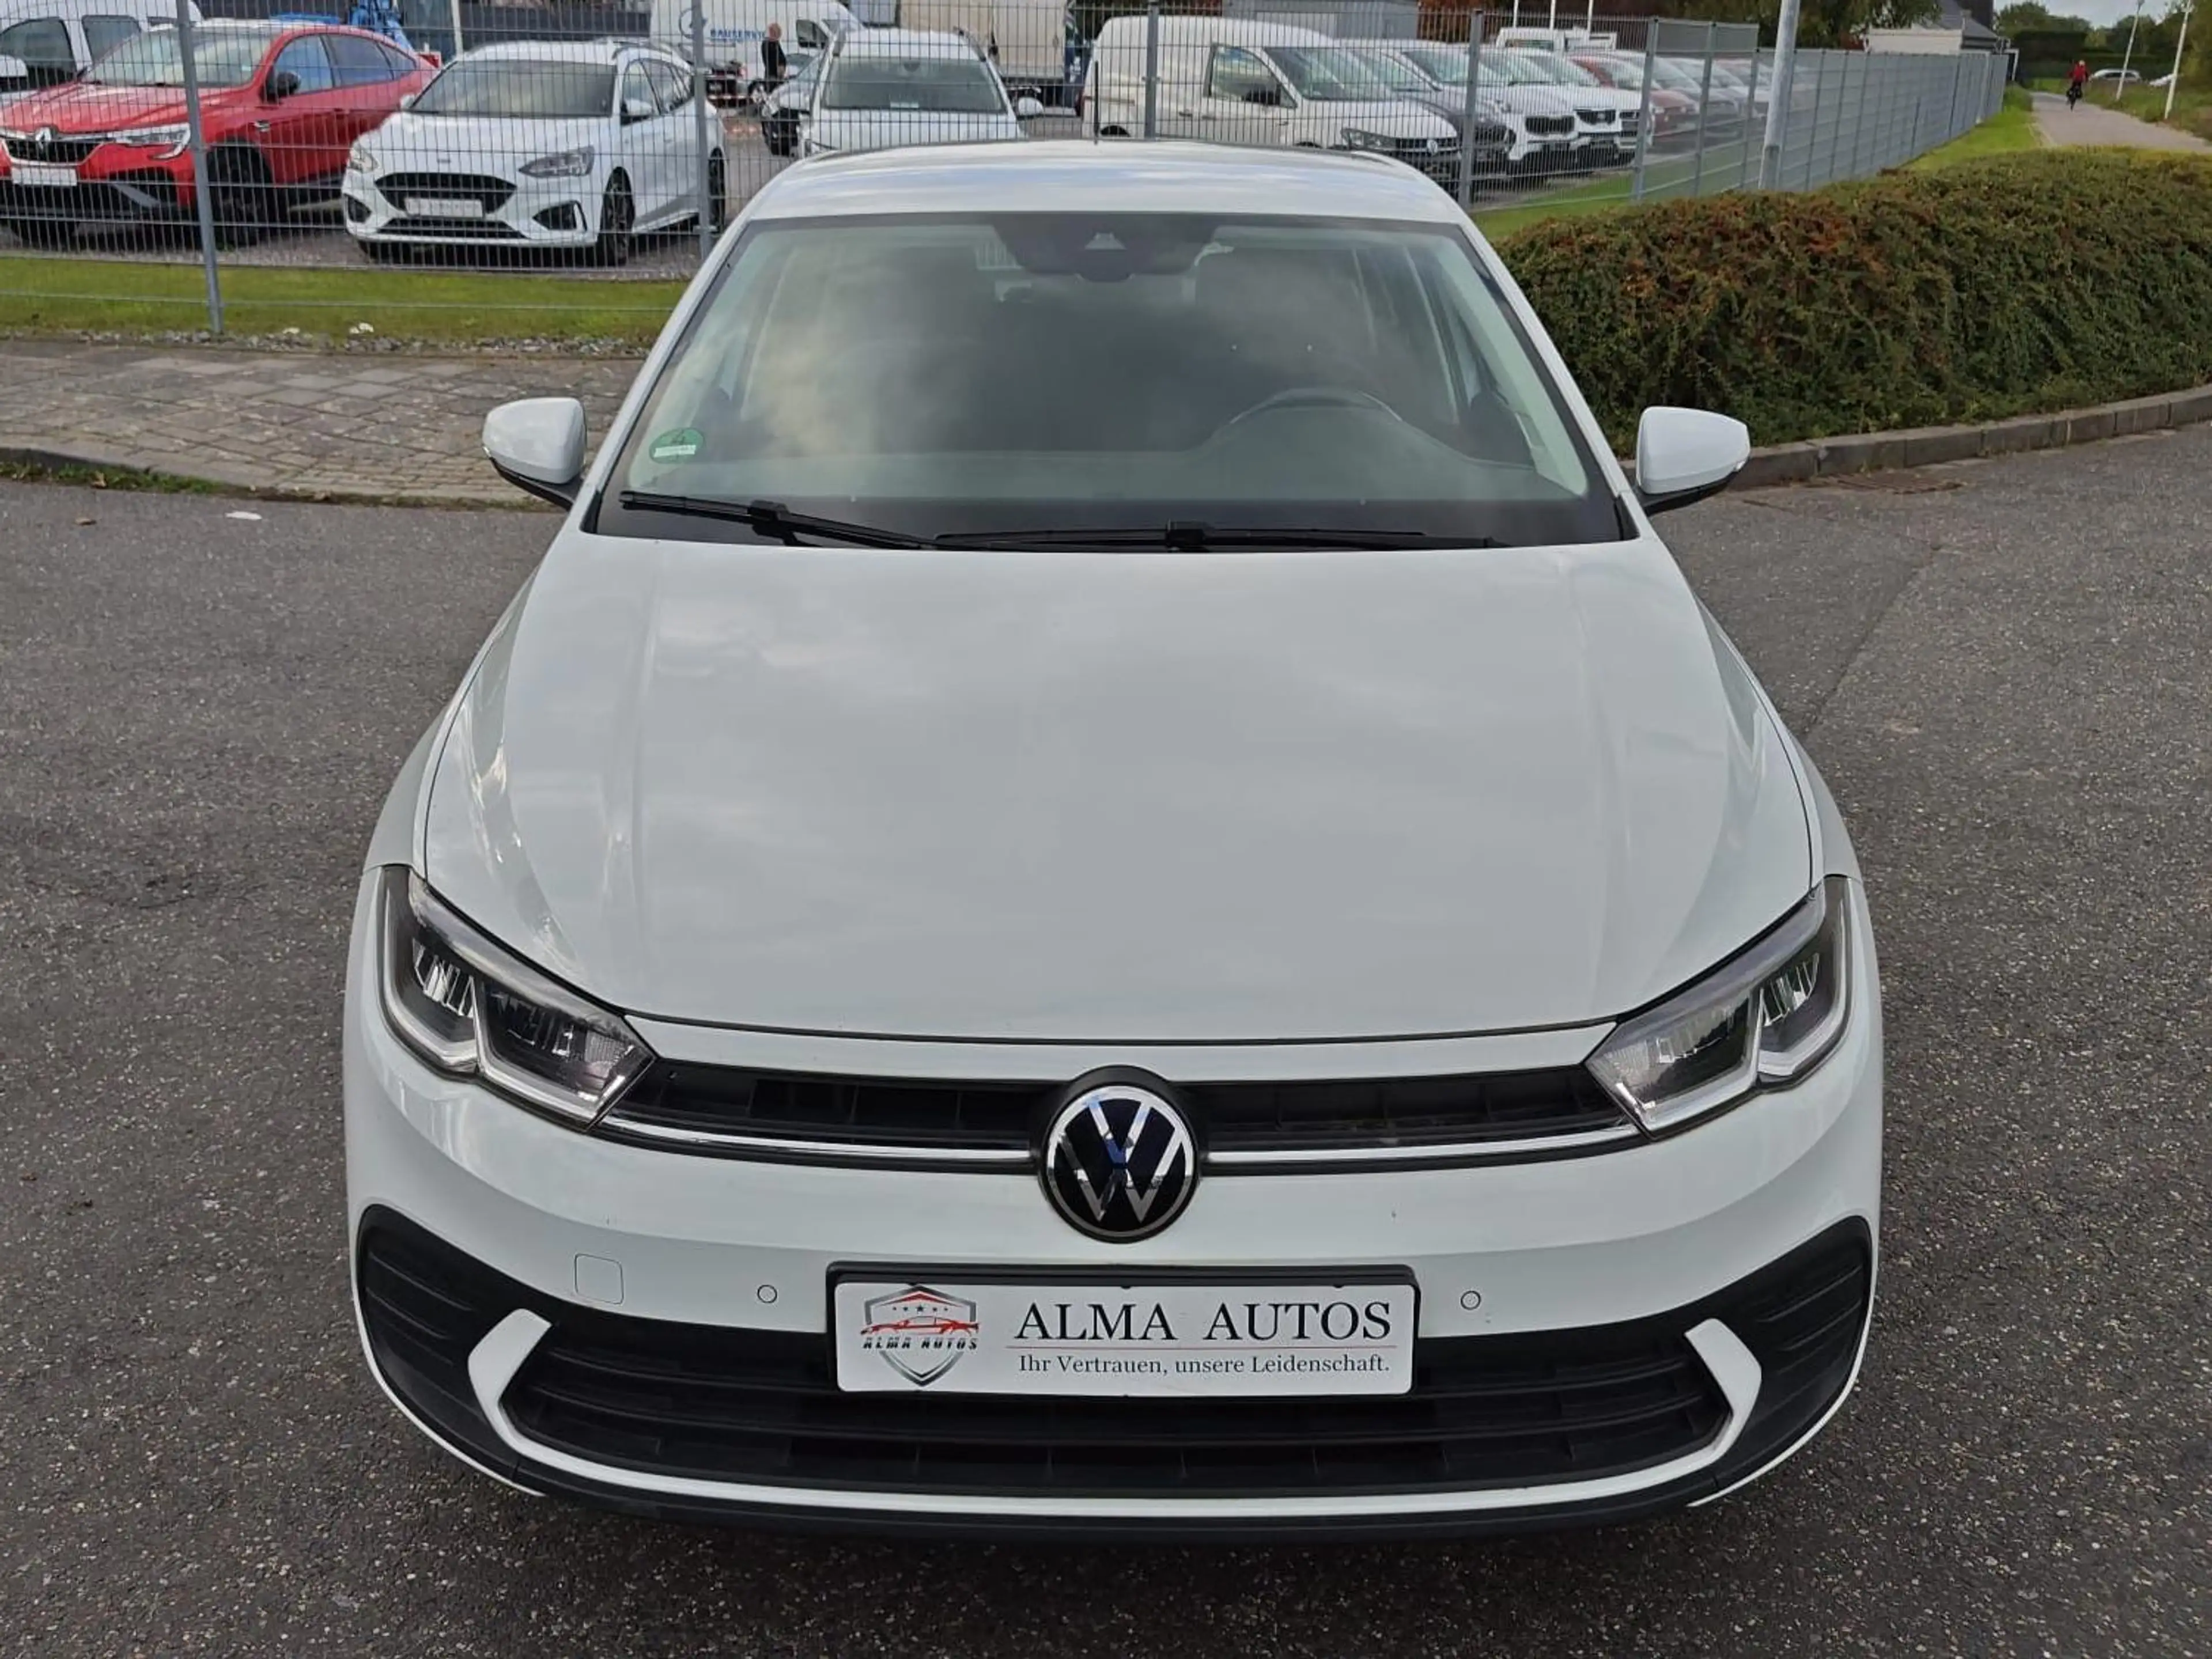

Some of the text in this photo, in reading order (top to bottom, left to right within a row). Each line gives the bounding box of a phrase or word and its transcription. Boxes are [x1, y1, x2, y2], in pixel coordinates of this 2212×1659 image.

[1014, 1301, 1391, 1340] ALMA AUTOS
[863, 1336, 978, 1350] ALMA AUTOS
[1019, 1354, 1390, 1375] Ihr Vertrauen, unsere Leidenschaft.
